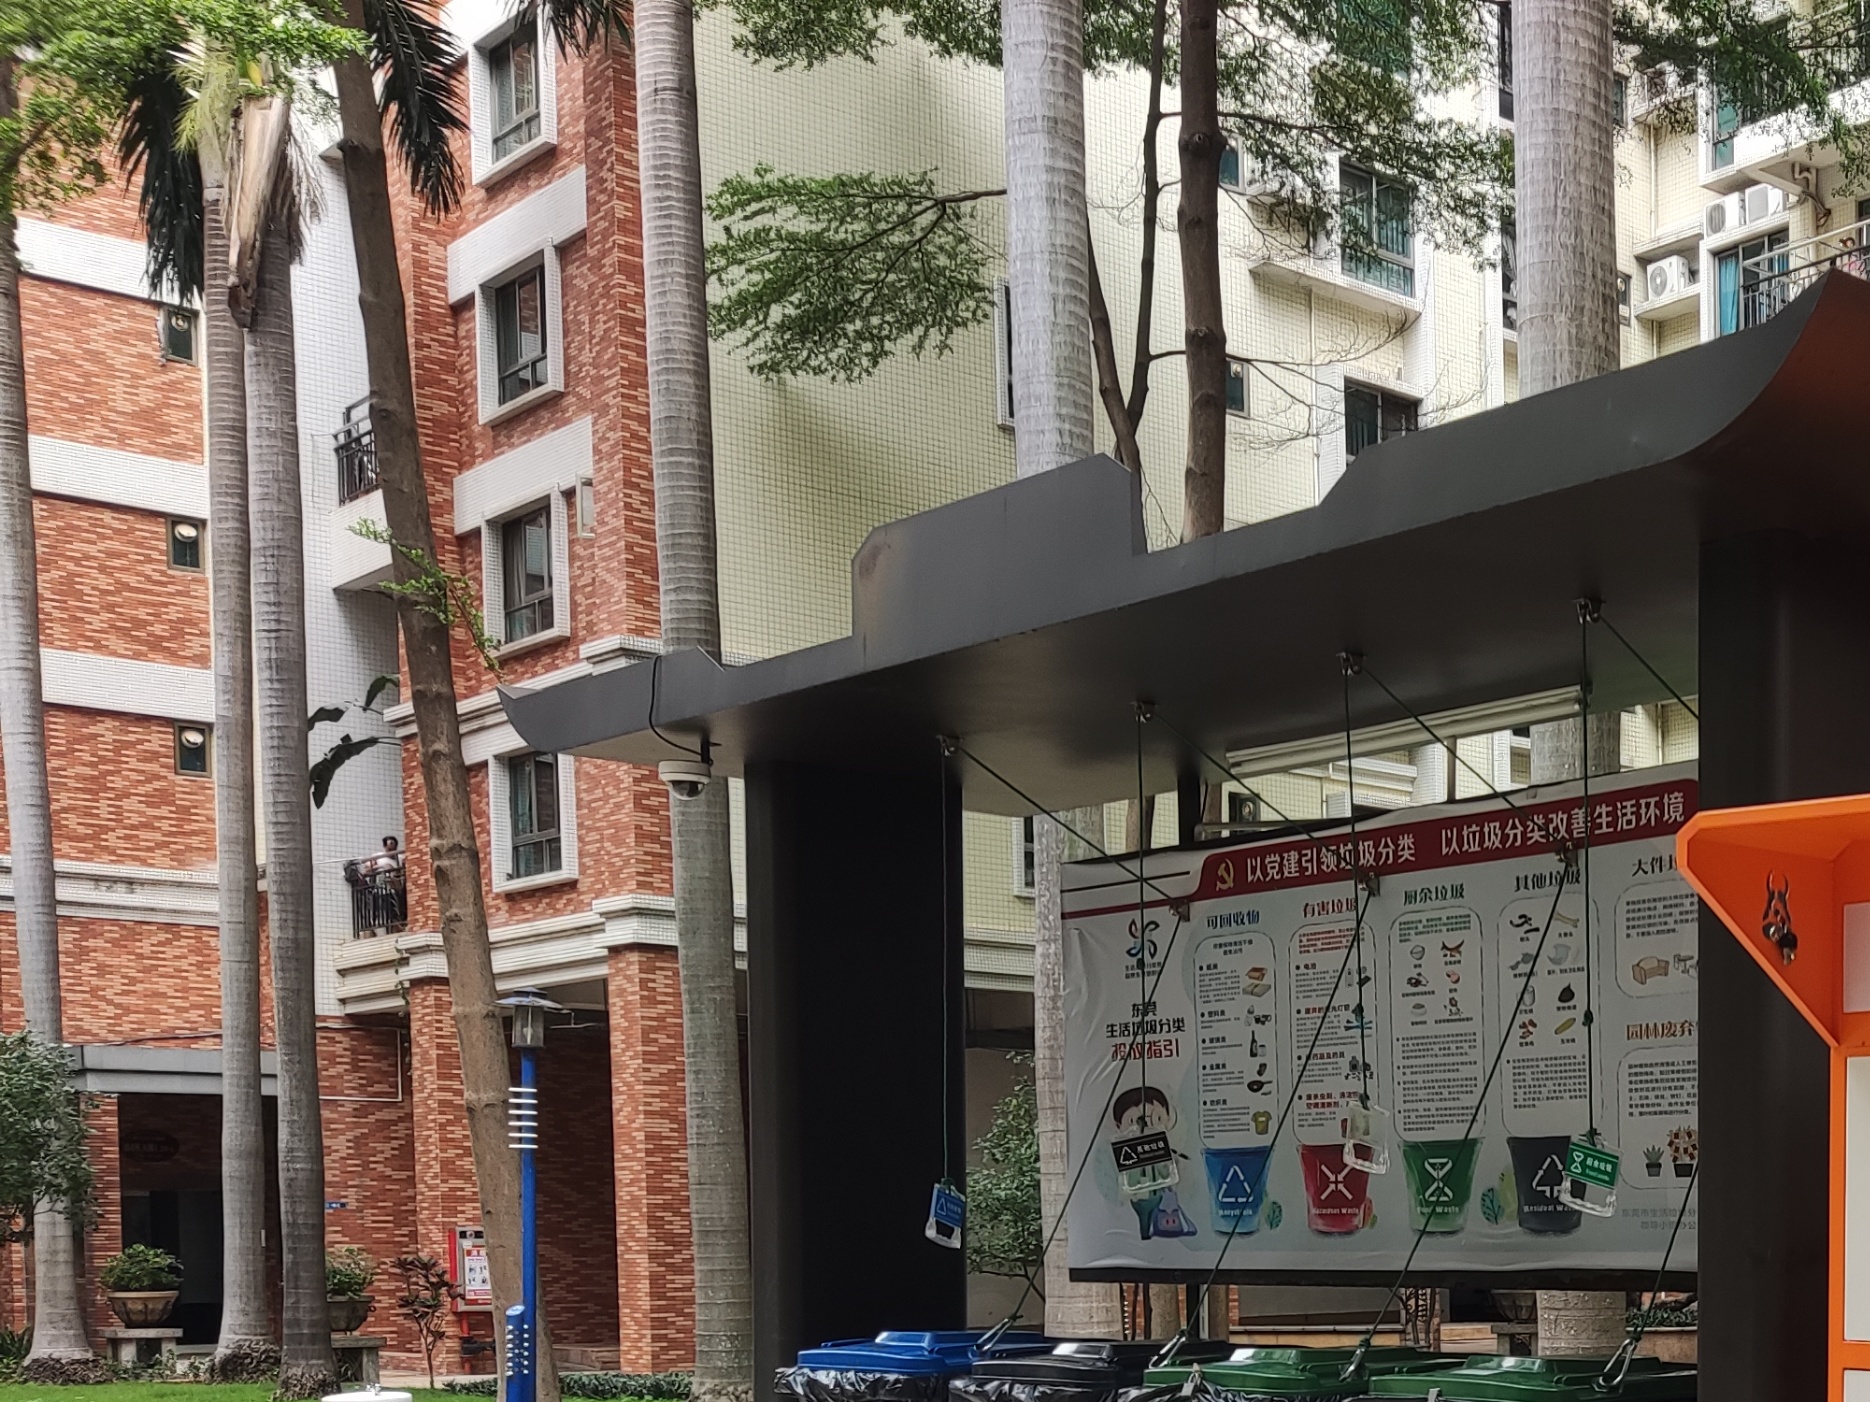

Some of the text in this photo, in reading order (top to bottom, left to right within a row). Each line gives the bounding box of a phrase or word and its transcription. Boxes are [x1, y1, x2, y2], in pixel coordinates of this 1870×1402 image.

[1246, 791, 1686, 883] 以党建引领垃圾分类 以垃圾分类改善生活环境
[1514, 868, 1581, 893] 其他垃圾
[1403, 882, 1465, 906] 厨余垃圾
[1303, 897, 1357, 918] 有害垃圾
[1206, 909, 1260, 930] 可回收物
[1106, 1016, 1186, 1039] 生活垃圾分类
[1627, 1019, 1698, 1040] 园林废弃
[1111, 1038, 1180, 1062] 投放指引
